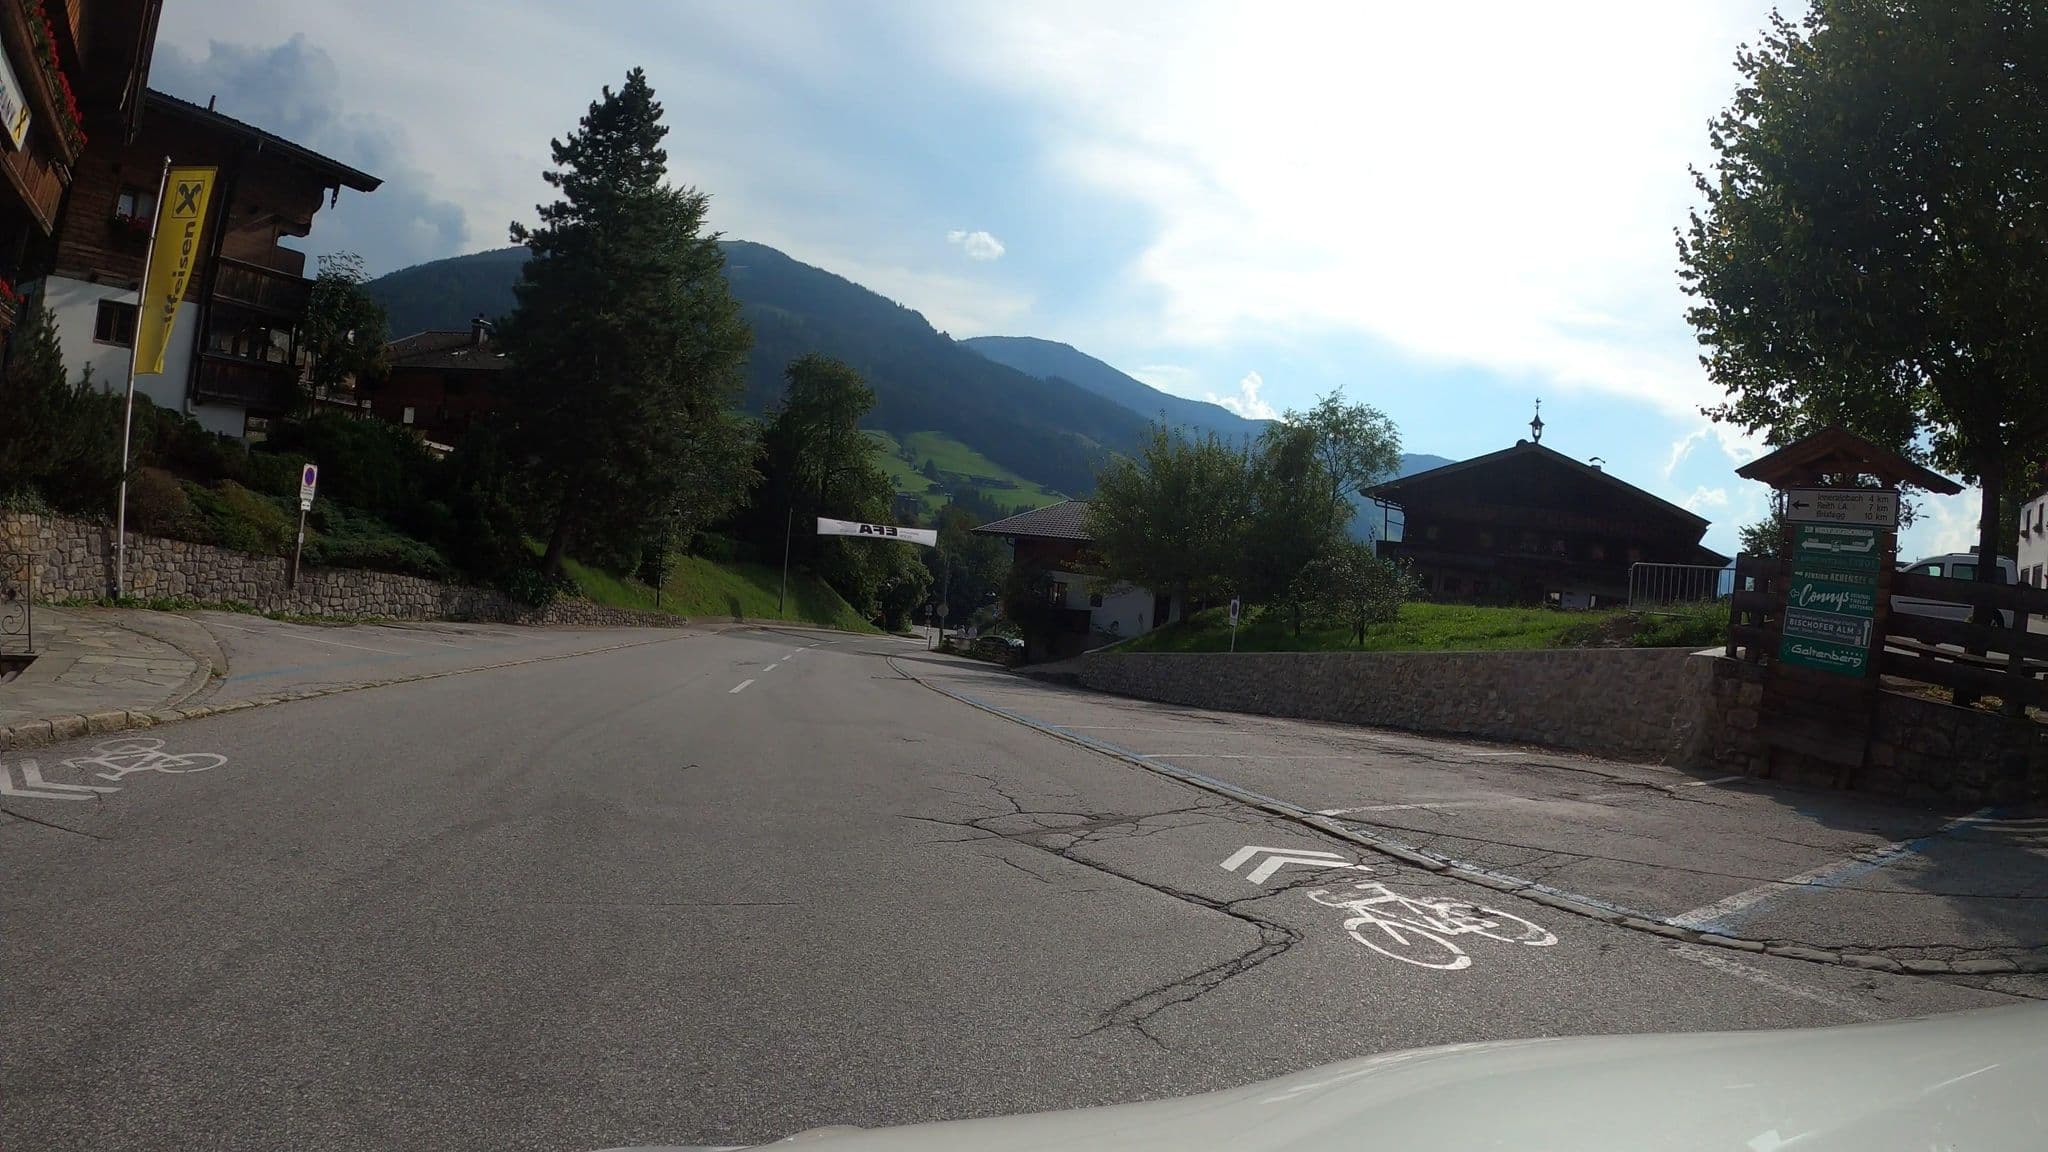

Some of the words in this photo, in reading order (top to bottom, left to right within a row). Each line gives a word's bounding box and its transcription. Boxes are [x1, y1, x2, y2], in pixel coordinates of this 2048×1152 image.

[1876, 504, 1889, 512] km
[1865, 512, 1873, 520] 10
[1875, 513, 1888, 521] km
[1789, 618, 1834, 632] BISCHOFER
[1836, 625, 1854, 634] ALM
[1791, 644, 1862, 667] Galtenberg
